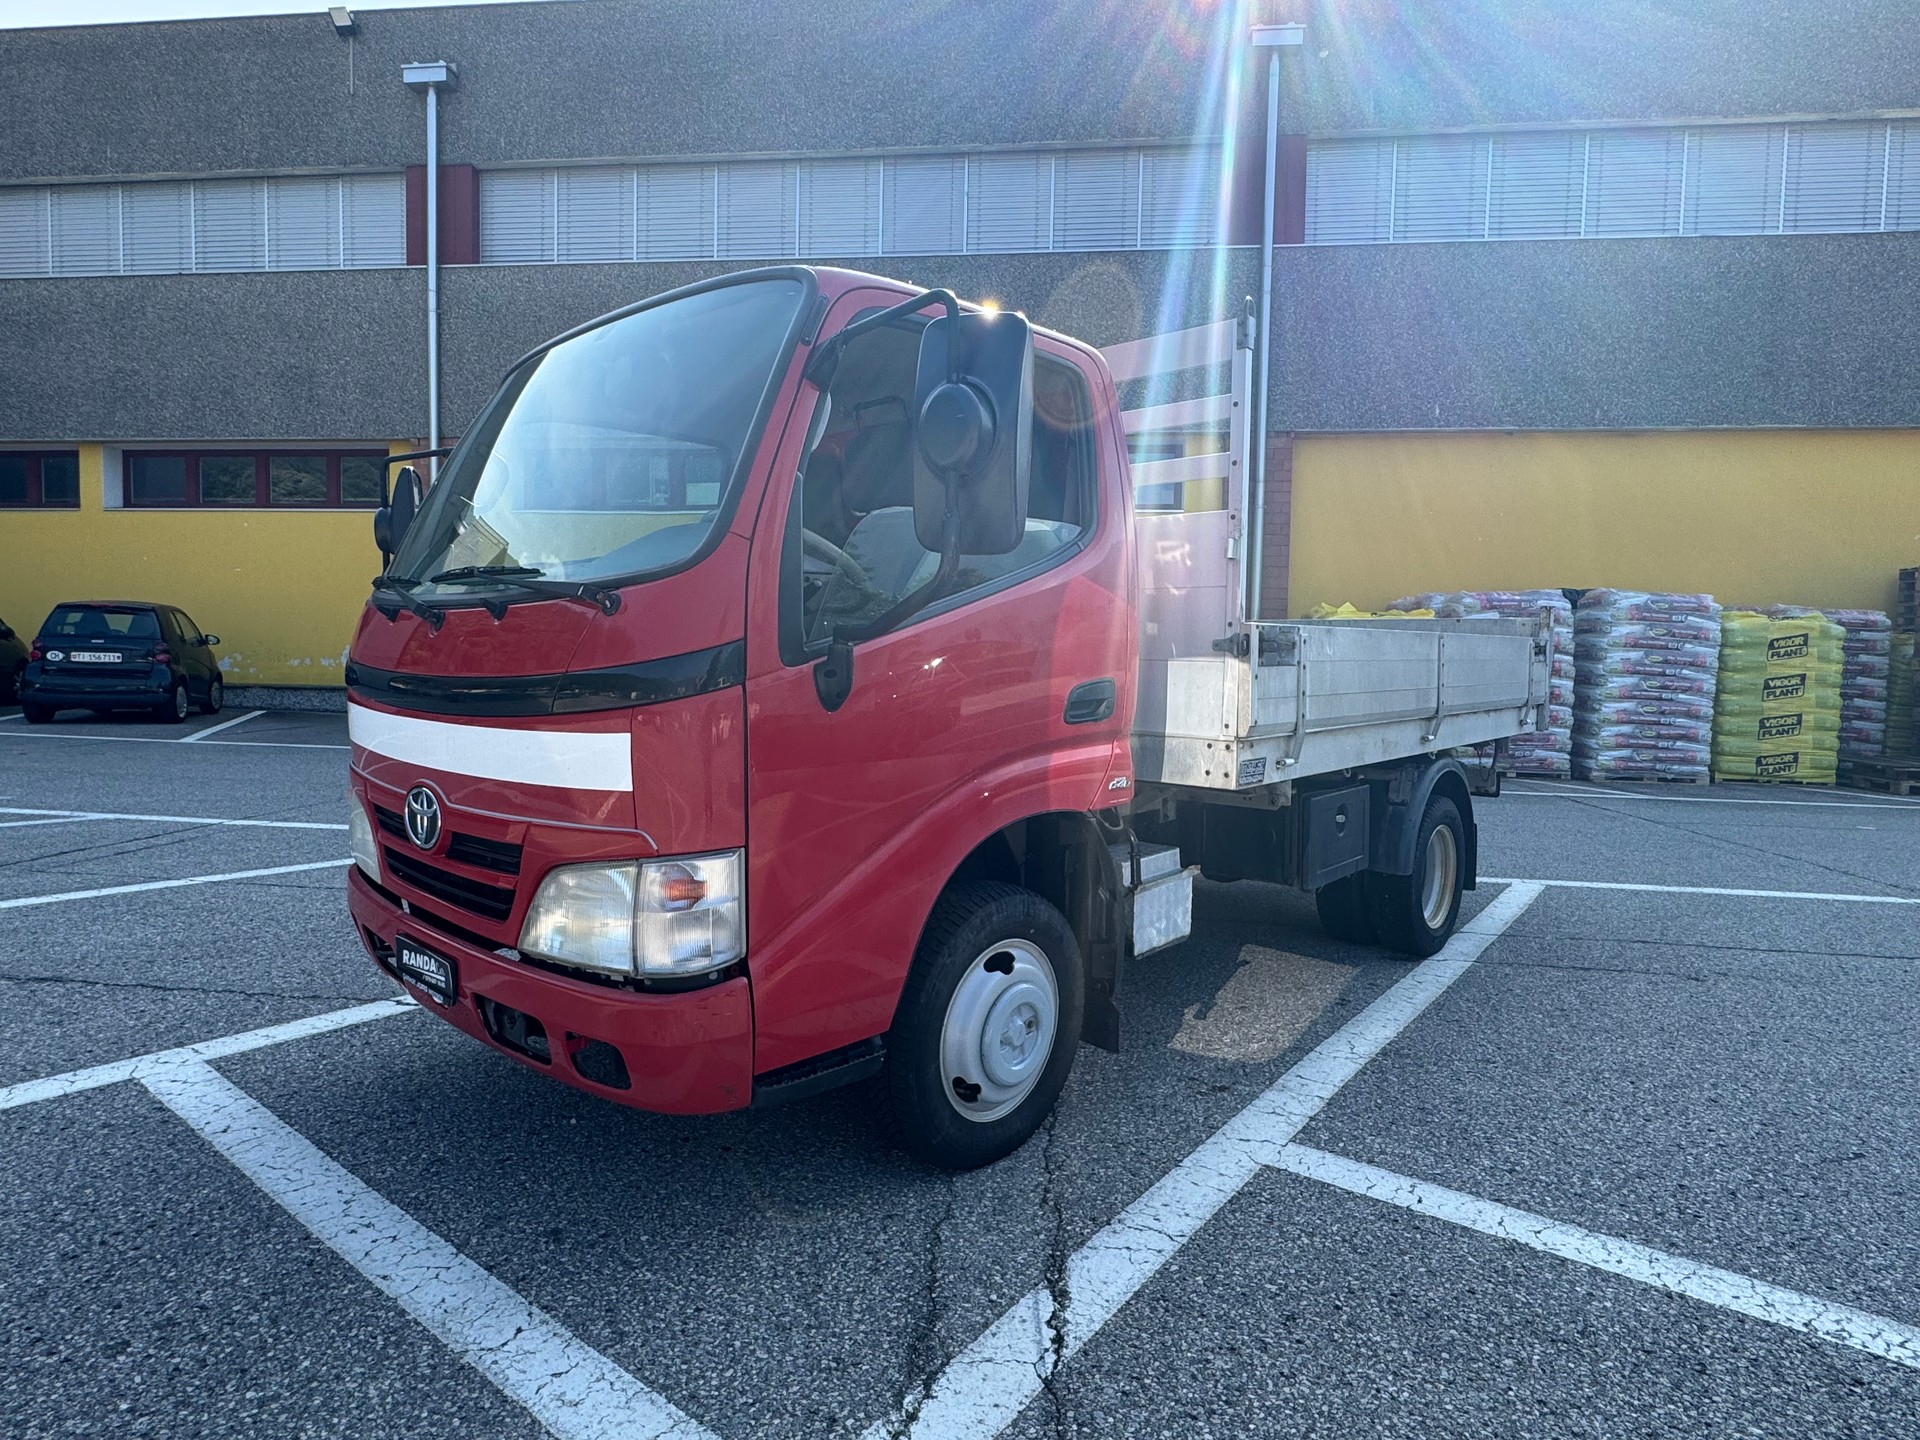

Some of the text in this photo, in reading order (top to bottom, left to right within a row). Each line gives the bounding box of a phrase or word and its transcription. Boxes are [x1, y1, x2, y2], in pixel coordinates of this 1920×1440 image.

[1773, 637, 1805, 648] VIGOR
[50, 652, 60, 660] CH
[1770, 647, 1804, 659] PLANT
[1768, 677, 1801, 688] VIGOR
[1766, 688, 1801, 698] PLANT
[1763, 716, 1798, 727] VIGOR
[1762, 727, 1797, 738] PLANT
[1760, 754, 1795, 765] VIGOR
[1760, 765, 1793, 776] PLANT
